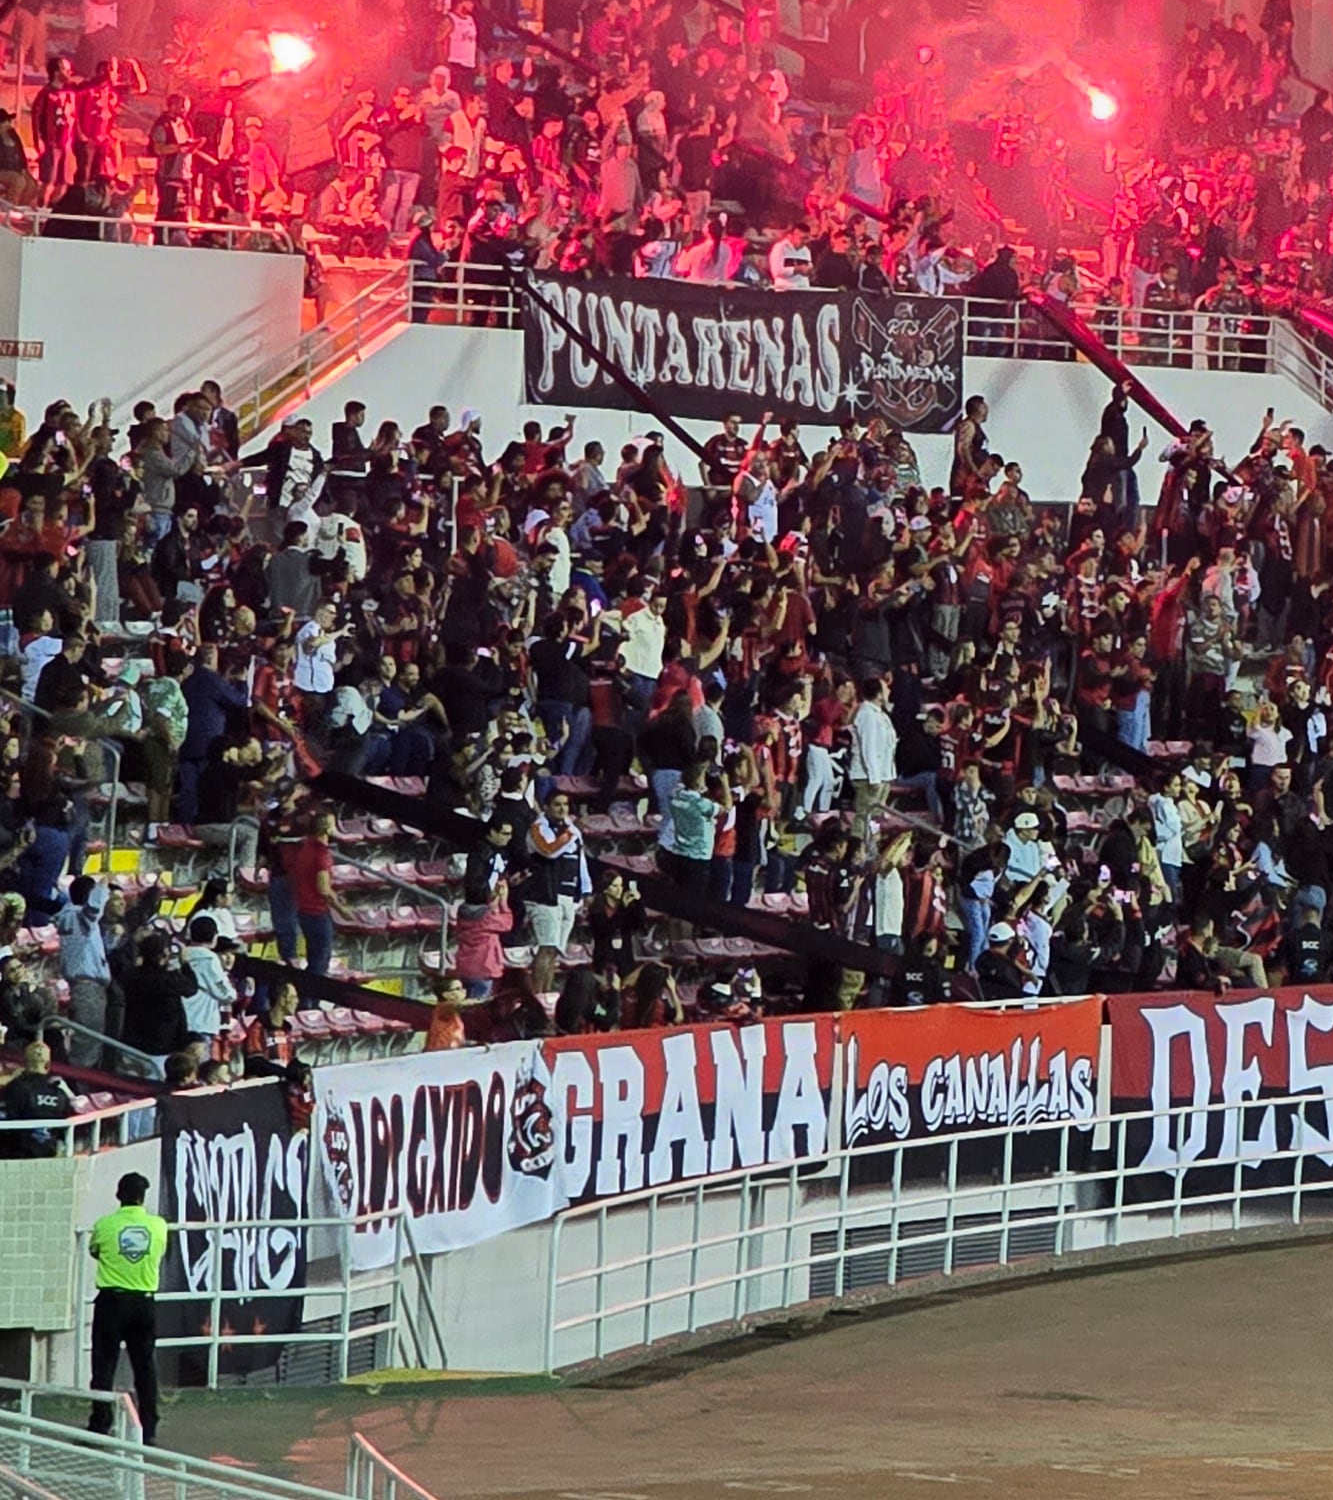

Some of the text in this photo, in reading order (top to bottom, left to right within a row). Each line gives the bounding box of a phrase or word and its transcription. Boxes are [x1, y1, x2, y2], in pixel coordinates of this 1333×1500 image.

[536, 278, 841, 413] PUNTARENAS
[552, 1021, 828, 1199] GRANA
[844, 1033, 1096, 1149] LOS CANALLAS
